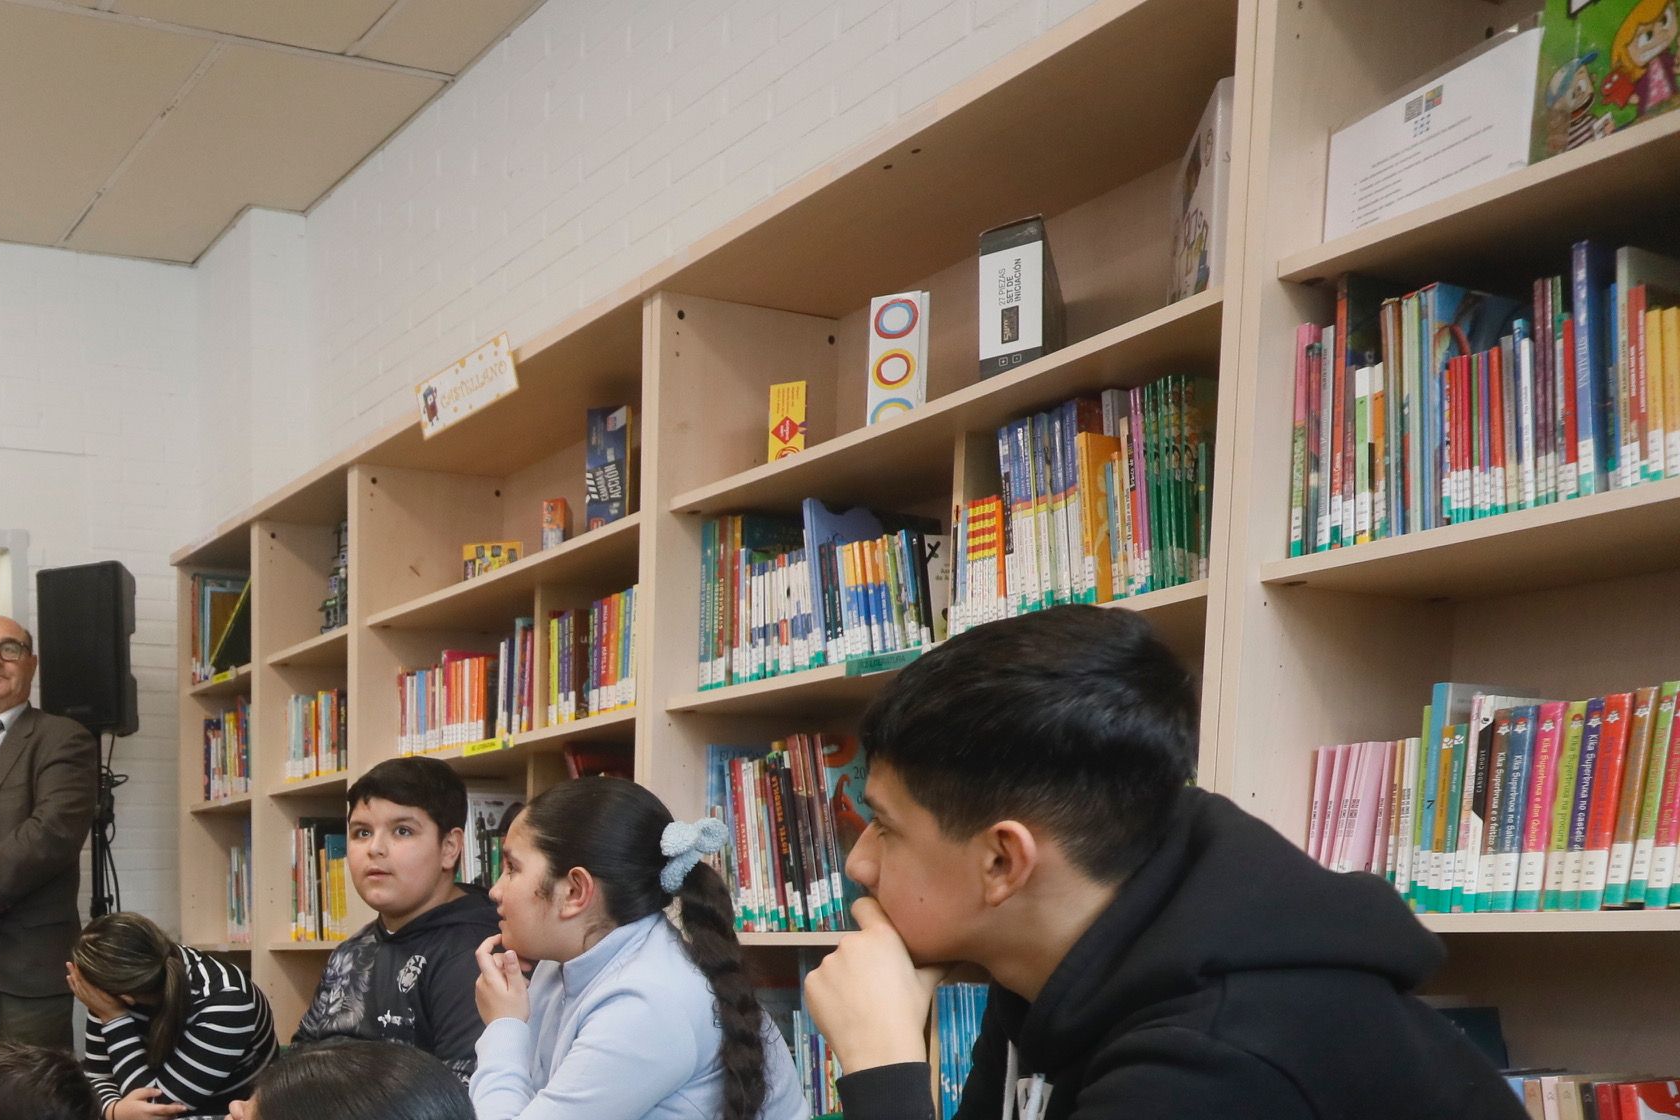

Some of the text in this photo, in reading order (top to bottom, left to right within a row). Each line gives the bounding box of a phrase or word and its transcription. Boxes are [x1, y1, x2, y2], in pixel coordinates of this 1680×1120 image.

[998, 268, 1006, 296] PIEZAS
[1006, 276, 1014, 304] SET DE
[604, 464, 622, 498] ACCIÓN
[1540, 737, 1551, 753] Kika
[1586, 734, 1599, 750] Kika
[1496, 752, 1506, 767] Kika
[1512, 755, 1523, 770] Kika
[1491, 769, 1504, 809] Superbruxa
[1535, 755, 1549, 796] Superbruxa
[1580, 753, 1595, 798] Superbruxa
[1506, 772, 1520, 813] Superbruxa
